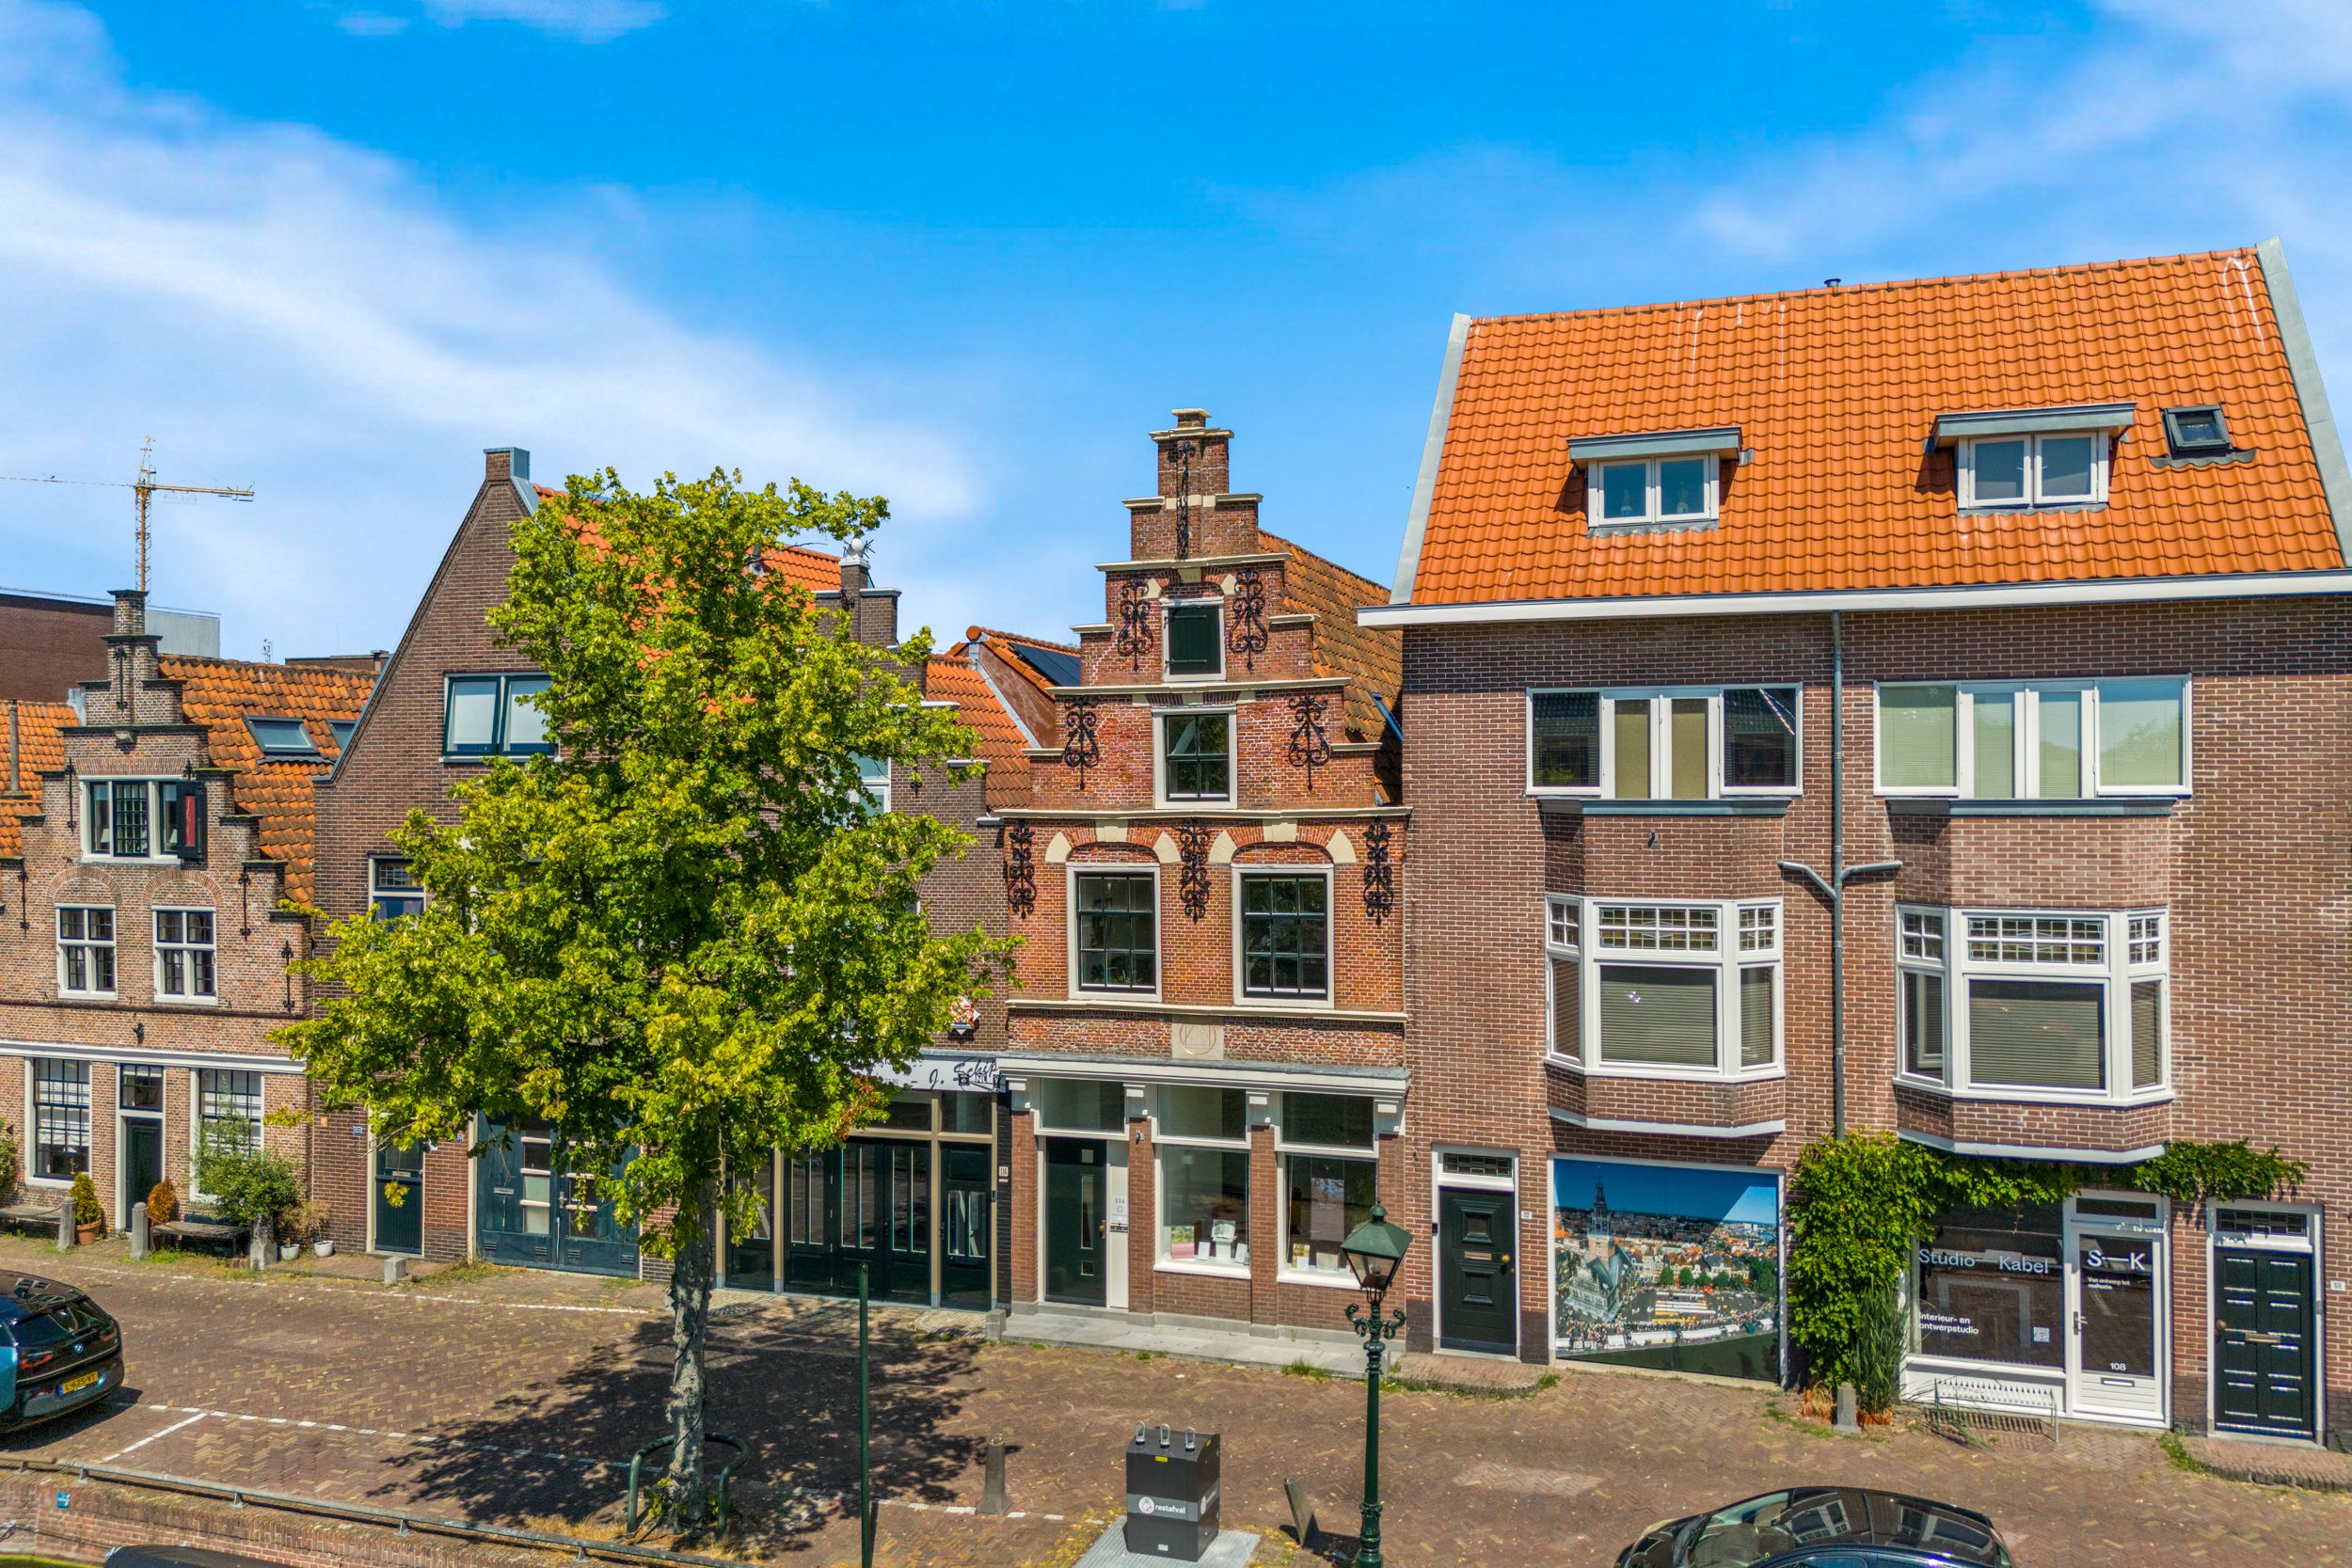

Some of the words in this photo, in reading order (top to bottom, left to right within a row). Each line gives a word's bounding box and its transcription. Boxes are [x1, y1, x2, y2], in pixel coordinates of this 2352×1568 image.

[1919, 1249, 1975, 1267] Studio
[1999, 1255, 2048, 1274] Kabel
[1919, 1323, 1979, 1335] ontwerpstudio
[2109, 1362, 2126, 1370] 108
[1155, 1504, 1185, 1513] restafval
